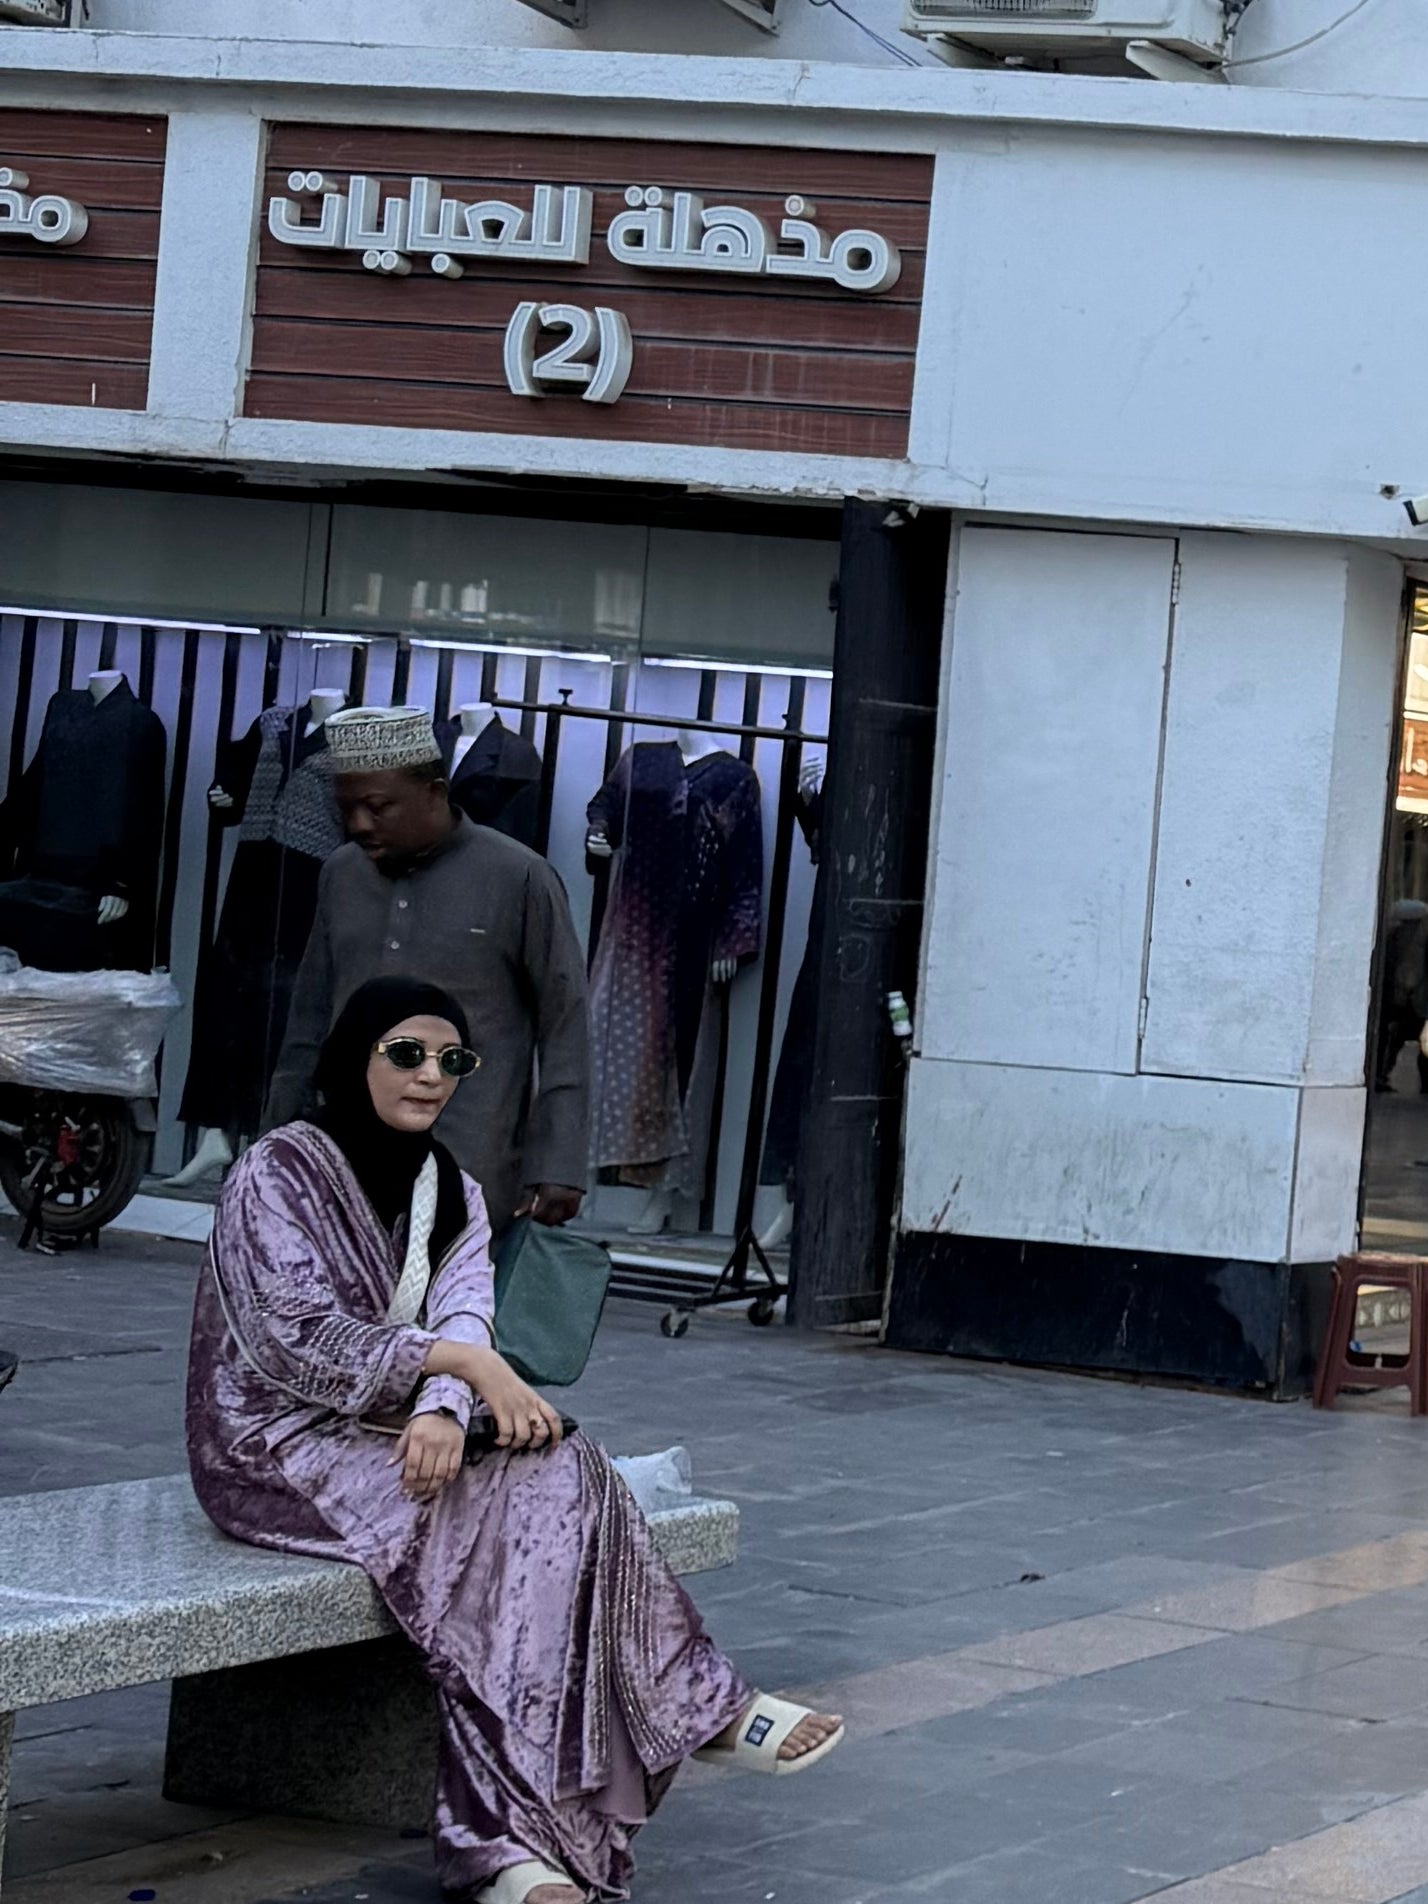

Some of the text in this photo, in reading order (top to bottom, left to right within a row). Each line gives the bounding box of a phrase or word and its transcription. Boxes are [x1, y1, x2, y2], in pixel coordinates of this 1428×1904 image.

[268, 174, 902, 295] مذهلة للعبايات
[503, 300, 633, 405] (2)
